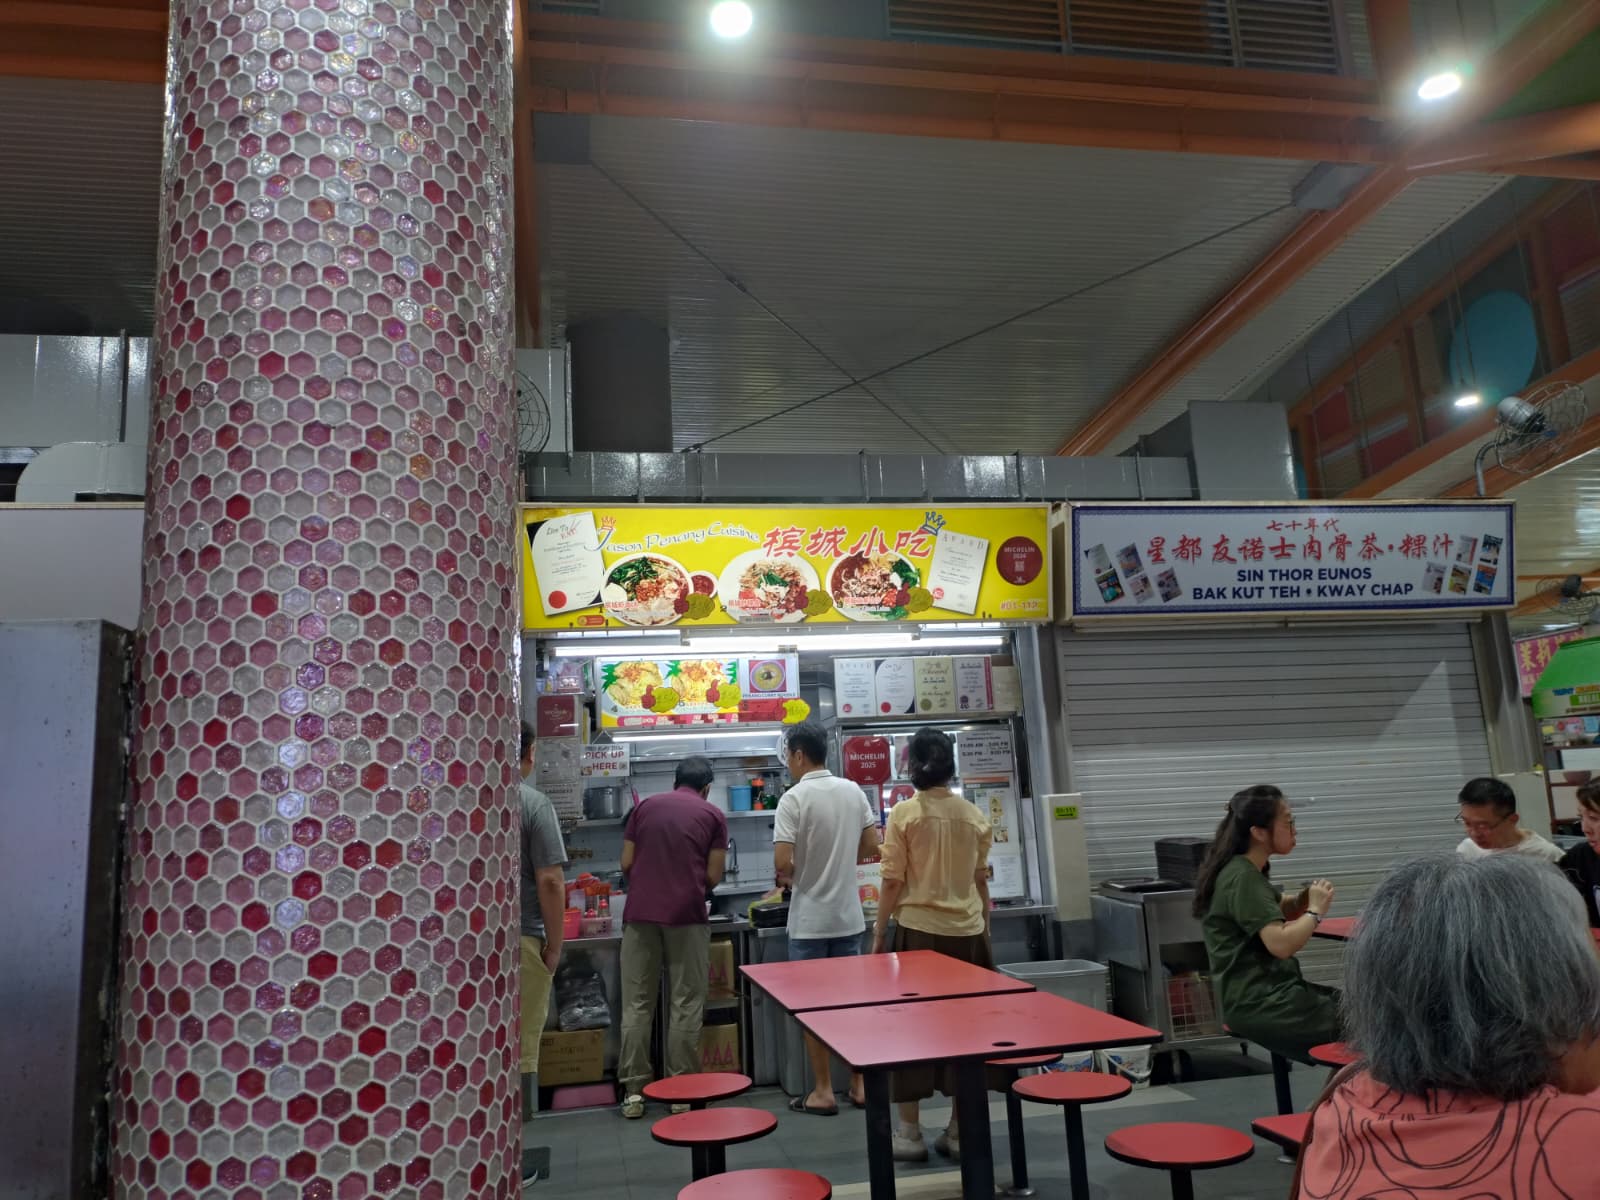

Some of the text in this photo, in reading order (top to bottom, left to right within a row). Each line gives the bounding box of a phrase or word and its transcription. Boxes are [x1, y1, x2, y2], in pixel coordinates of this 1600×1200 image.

[1266, 518, 1340, 532] 七十年代
[584, 528, 642, 551] Jason
[646, 526, 705, 547] Penang
[708, 522, 758, 541] Cuisine
[763, 527, 931, 558] 槟城小吃
[1237, 567, 1372, 582] SIN THOR EUNOS
[1192, 583, 1413, 600] BAK KUT TEH KWAY CHAP
[585, 751, 607, 759] PICK
[592, 762, 617, 770] HERE
